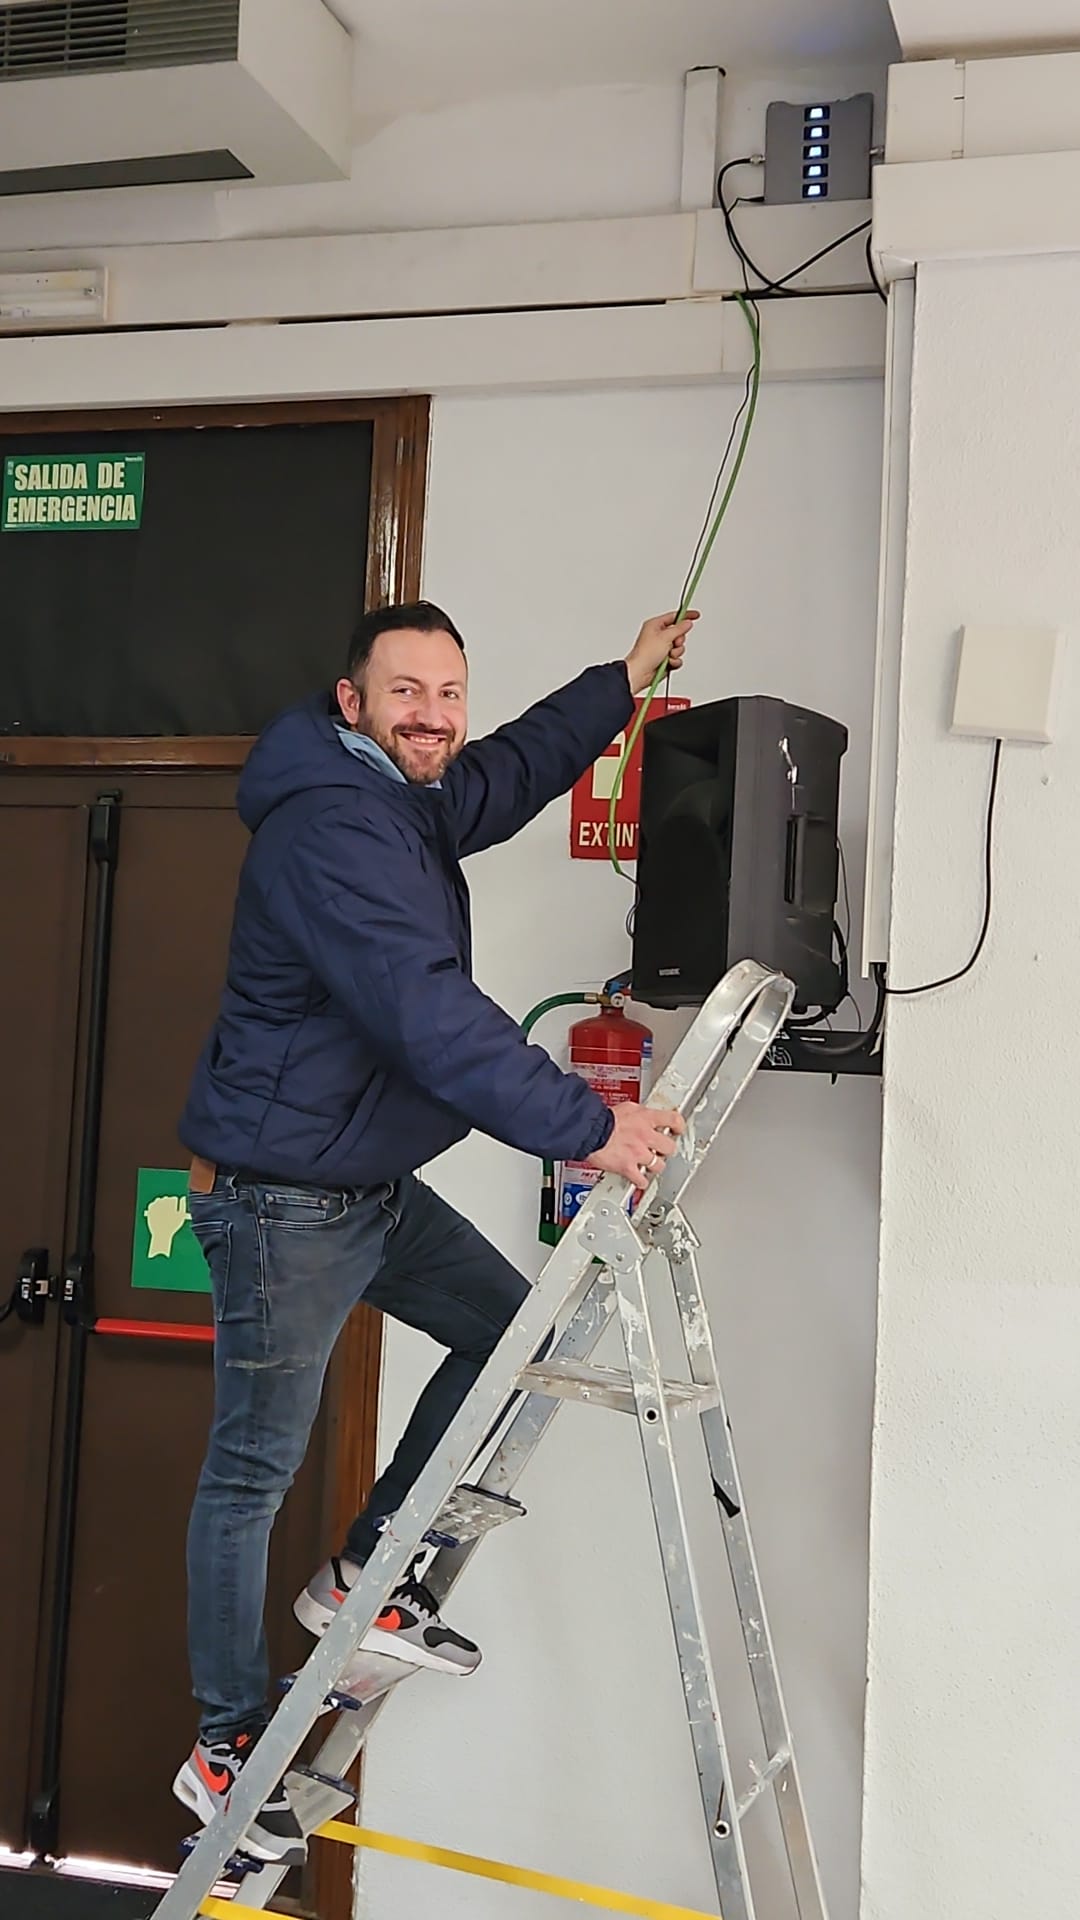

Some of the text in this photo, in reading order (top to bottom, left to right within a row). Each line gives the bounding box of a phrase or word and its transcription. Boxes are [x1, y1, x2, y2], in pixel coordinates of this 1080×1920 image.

[15, 463, 88, 491] SALIDA
[98, 462, 125, 489] DE
[7, 494, 136, 523] EMERGENCIA
[579, 821, 639, 848] EXTIN
